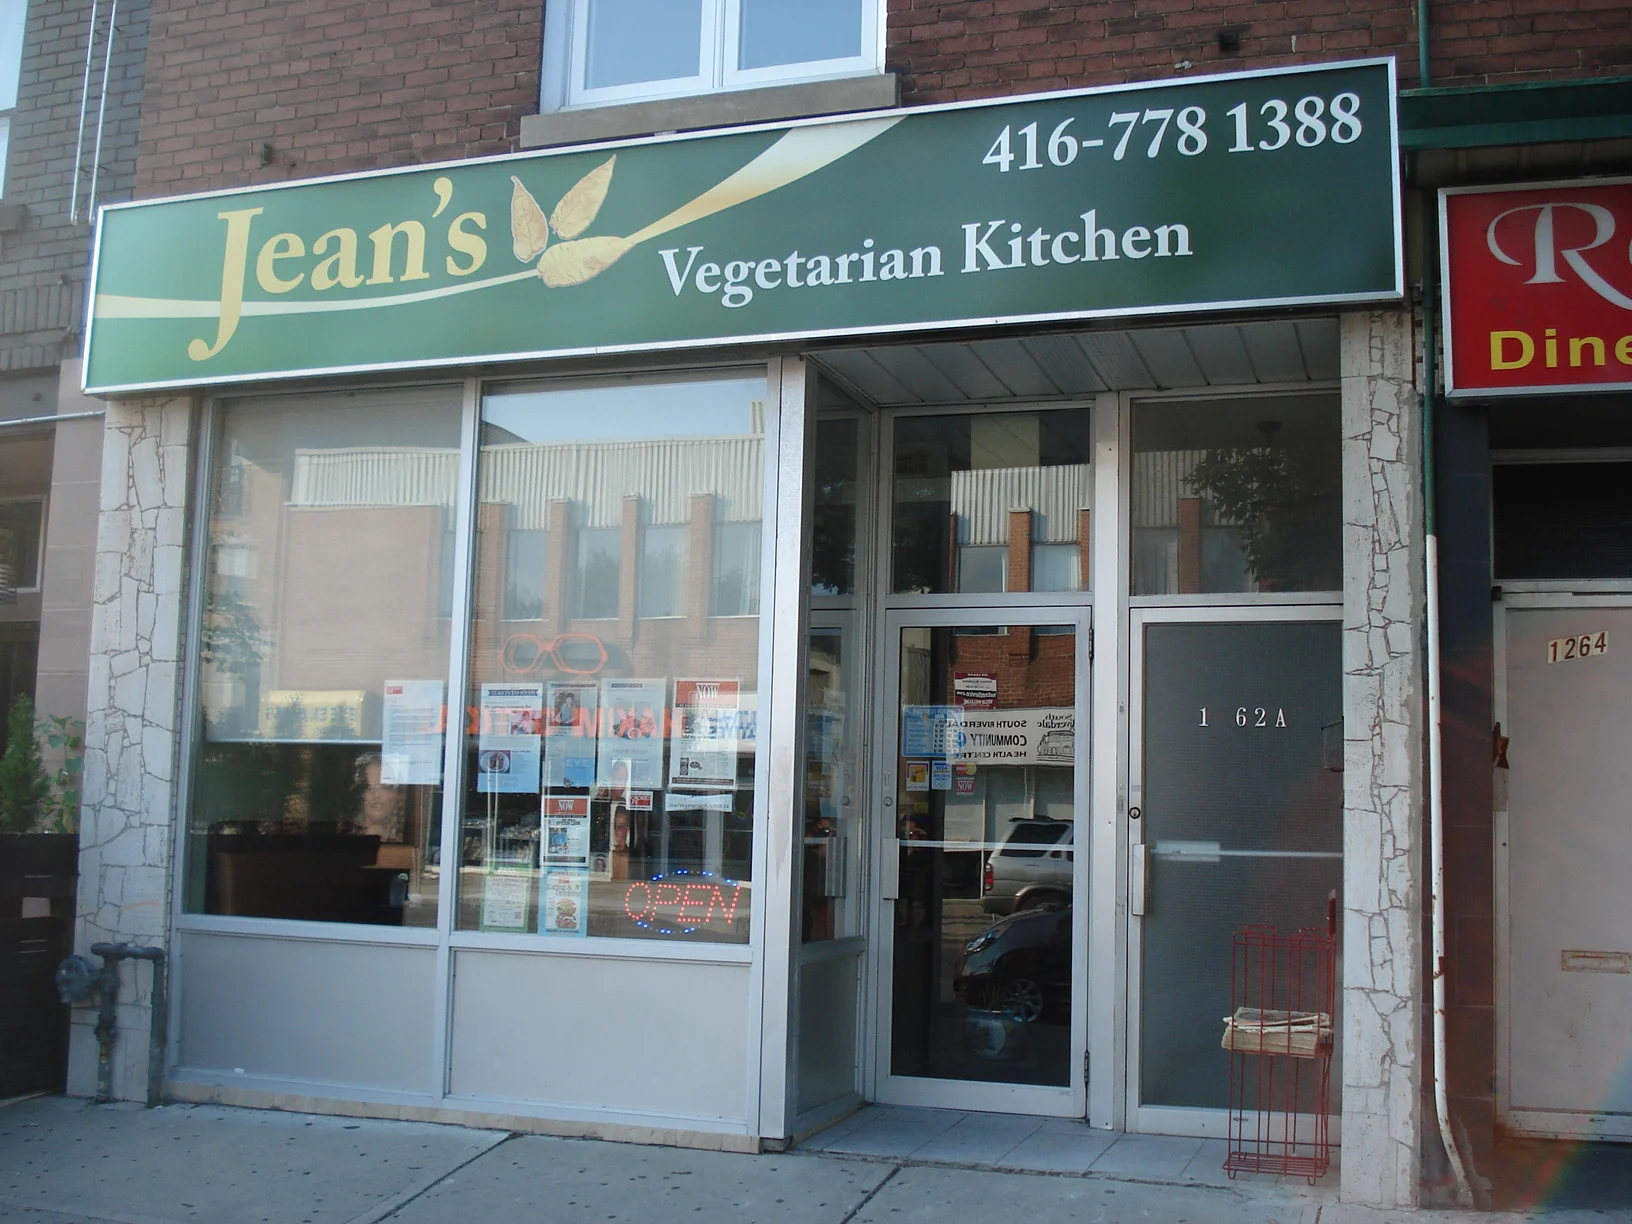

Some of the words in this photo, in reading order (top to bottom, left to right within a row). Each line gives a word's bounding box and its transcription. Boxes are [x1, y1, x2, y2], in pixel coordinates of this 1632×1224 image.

[981, 106, 1208, 173] 416-778
[1226, 92, 1363, 153] 1388
[188, 176, 488, 362] Jean's
[658, 238, 945, 309] Vegetarian
[961, 209, 1194, 274] Kitchen
[1486, 202, 1632, 312] R
[1550, 632, 1607, 663] 1264
[695, 683, 720, 700] NOW
[556, 799, 575, 811] NOW
[957, 780, 974, 792] NOW
[624, 881, 742, 925] OPEN
